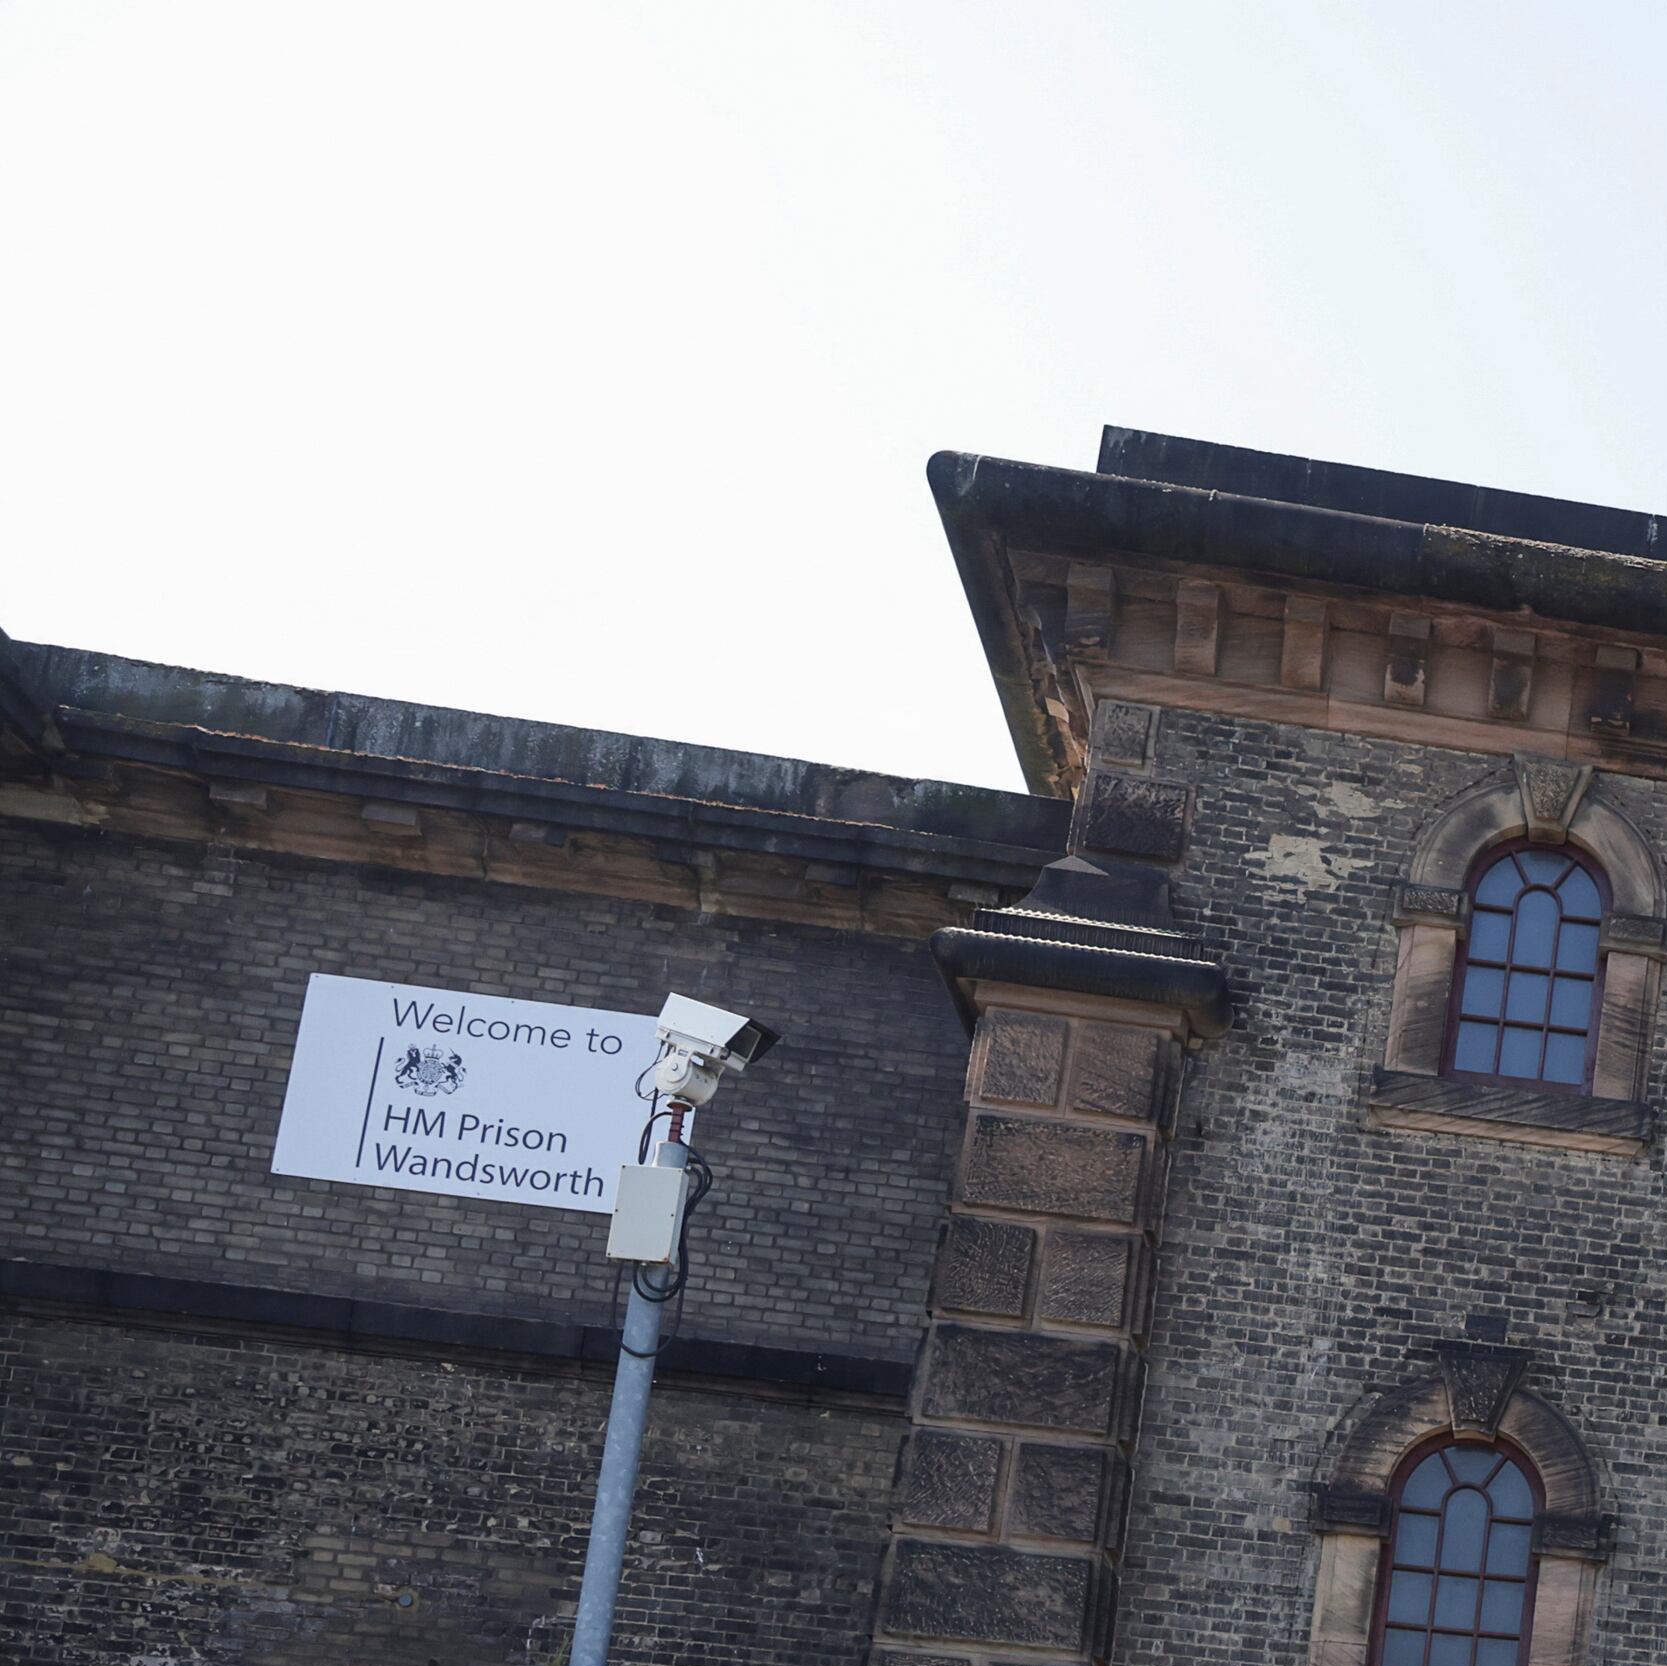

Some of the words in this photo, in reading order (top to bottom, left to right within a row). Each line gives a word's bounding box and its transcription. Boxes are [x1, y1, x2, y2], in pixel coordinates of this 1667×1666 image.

[392, 998, 571, 1049] Welcome
[586, 1029, 623, 1055] to
[383, 1104, 446, 1138] HM
[457, 1114, 568, 1153] Prison
[375, 1142, 604, 1197] Wandsworth
